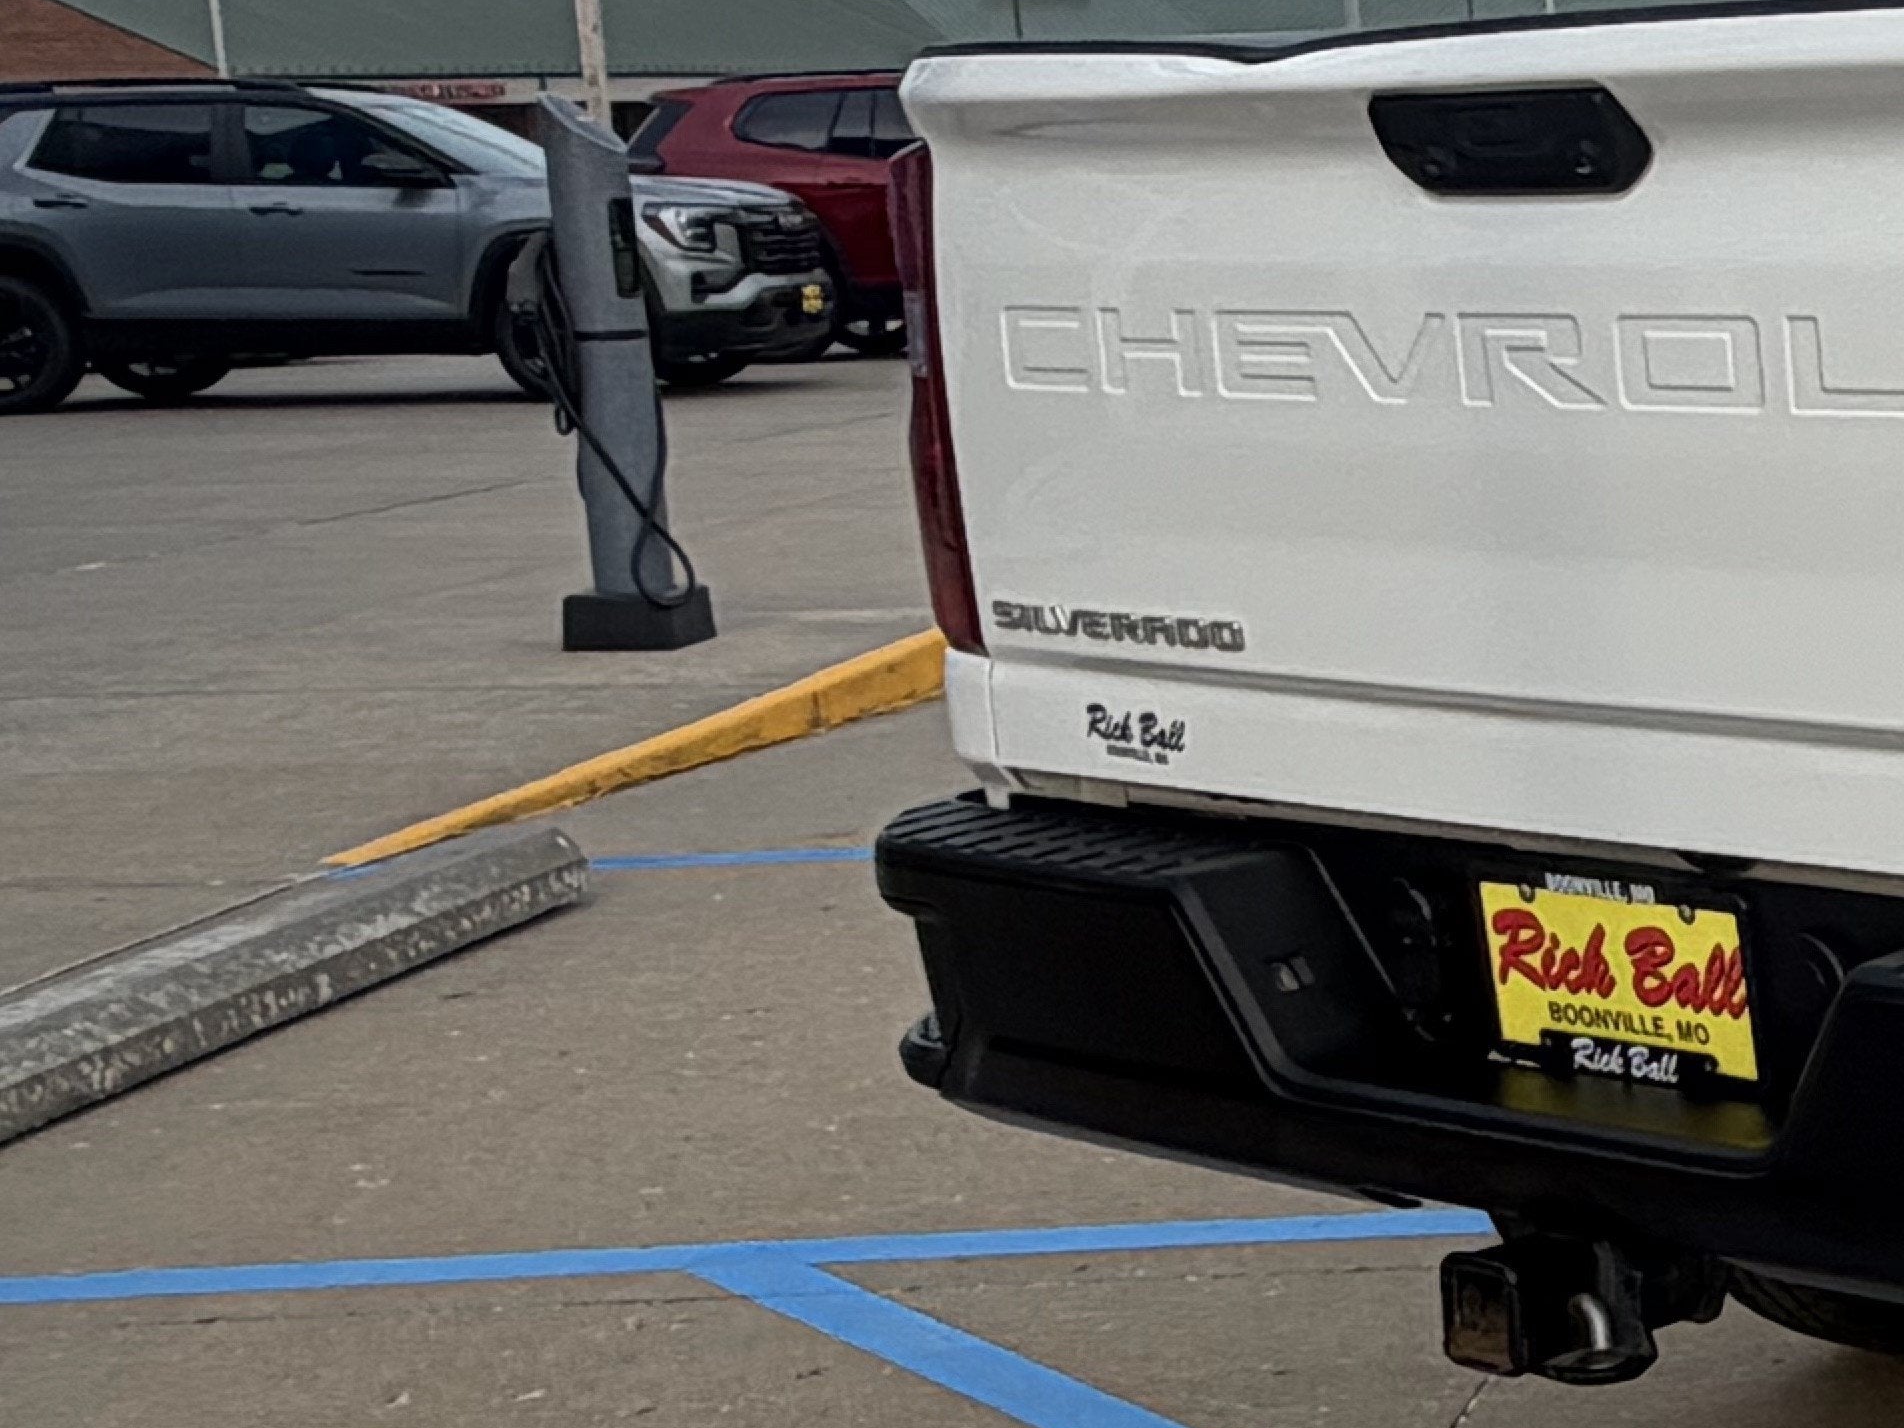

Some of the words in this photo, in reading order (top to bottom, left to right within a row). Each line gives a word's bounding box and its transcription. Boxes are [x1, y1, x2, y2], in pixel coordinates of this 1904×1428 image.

[993, 600, 1246, 653] SILVERADO
[1086, 703, 1133, 744] Rick
[1139, 711, 1186, 752] Ball
[1492, 907, 1617, 999] Rick
[1624, 925, 1748, 1019] Ball
[1548, 1000, 1674, 1043] BOONVILLE,
[1675, 1021, 1710, 1045] MO
[1571, 1037, 1625, 1074] Rick
[1627, 1046, 1679, 1083] Ball
